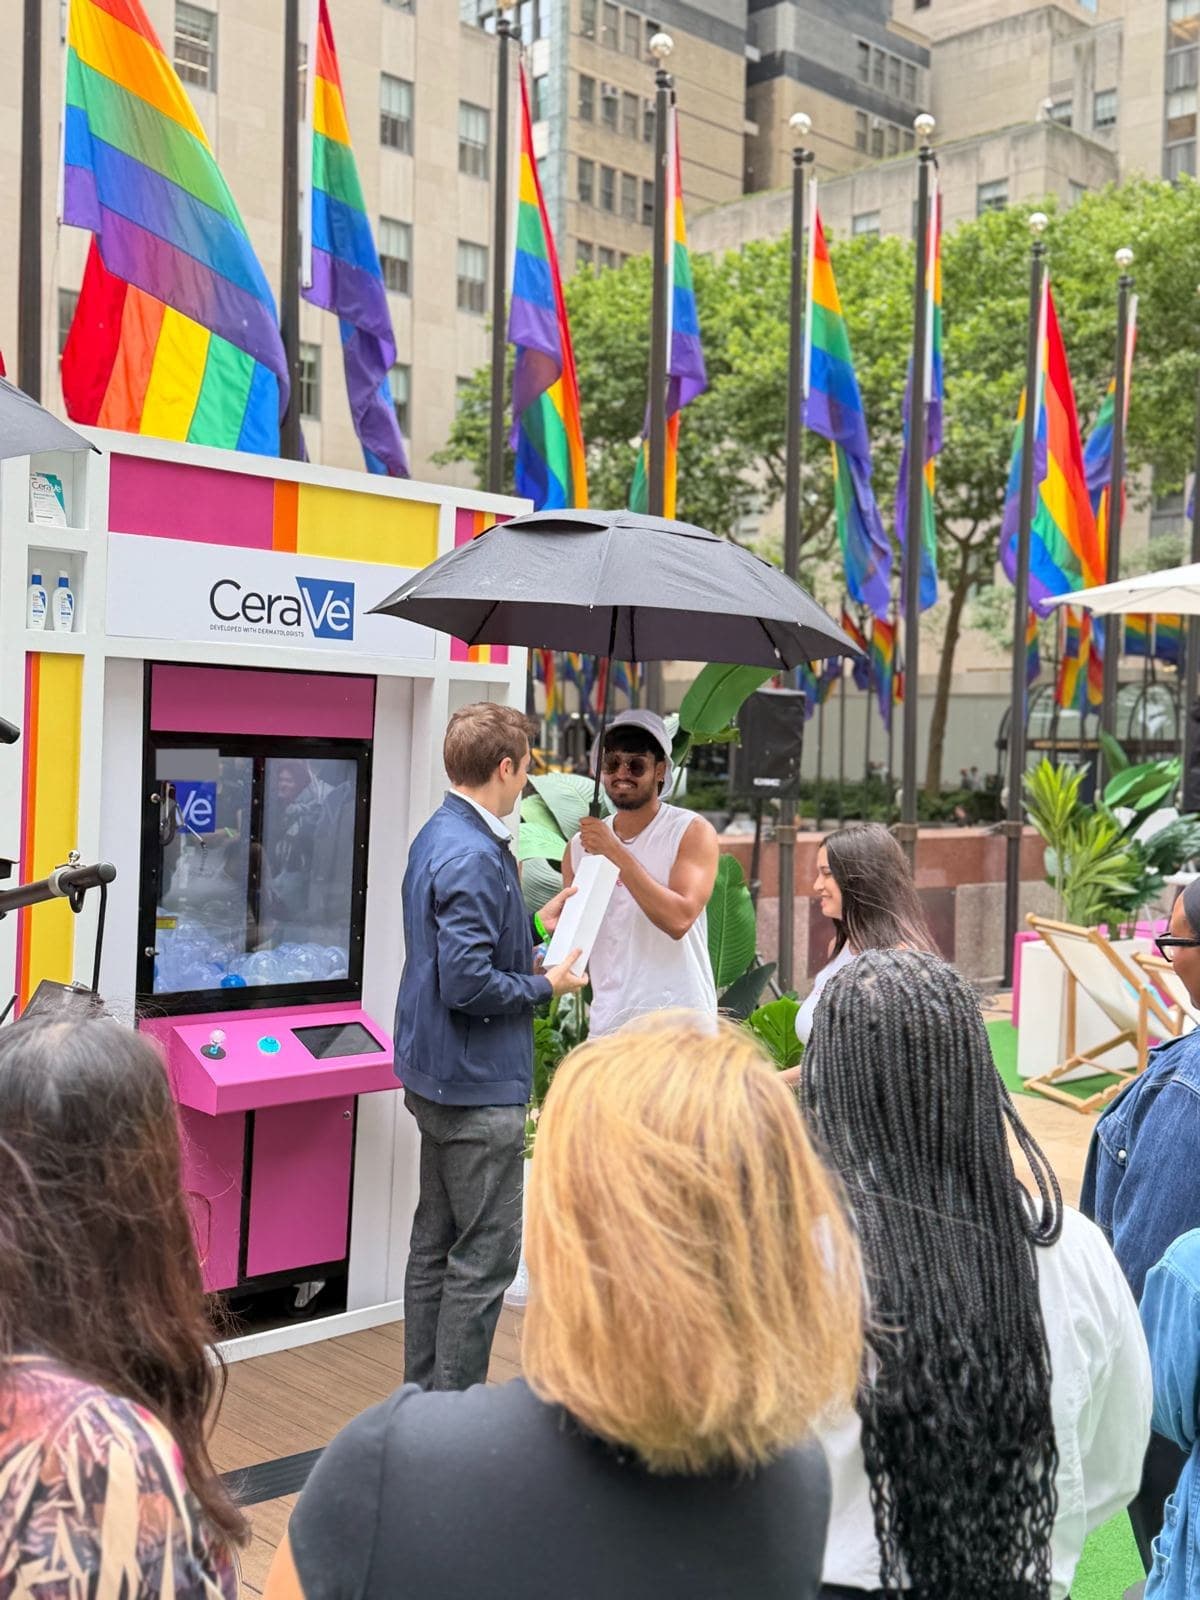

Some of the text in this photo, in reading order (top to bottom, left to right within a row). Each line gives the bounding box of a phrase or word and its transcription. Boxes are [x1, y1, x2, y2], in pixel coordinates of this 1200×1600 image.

[209, 579, 351, 632] CeraVe
[209, 624, 305, 638] DEVELOPED WITH DERMATOLOGISTS
